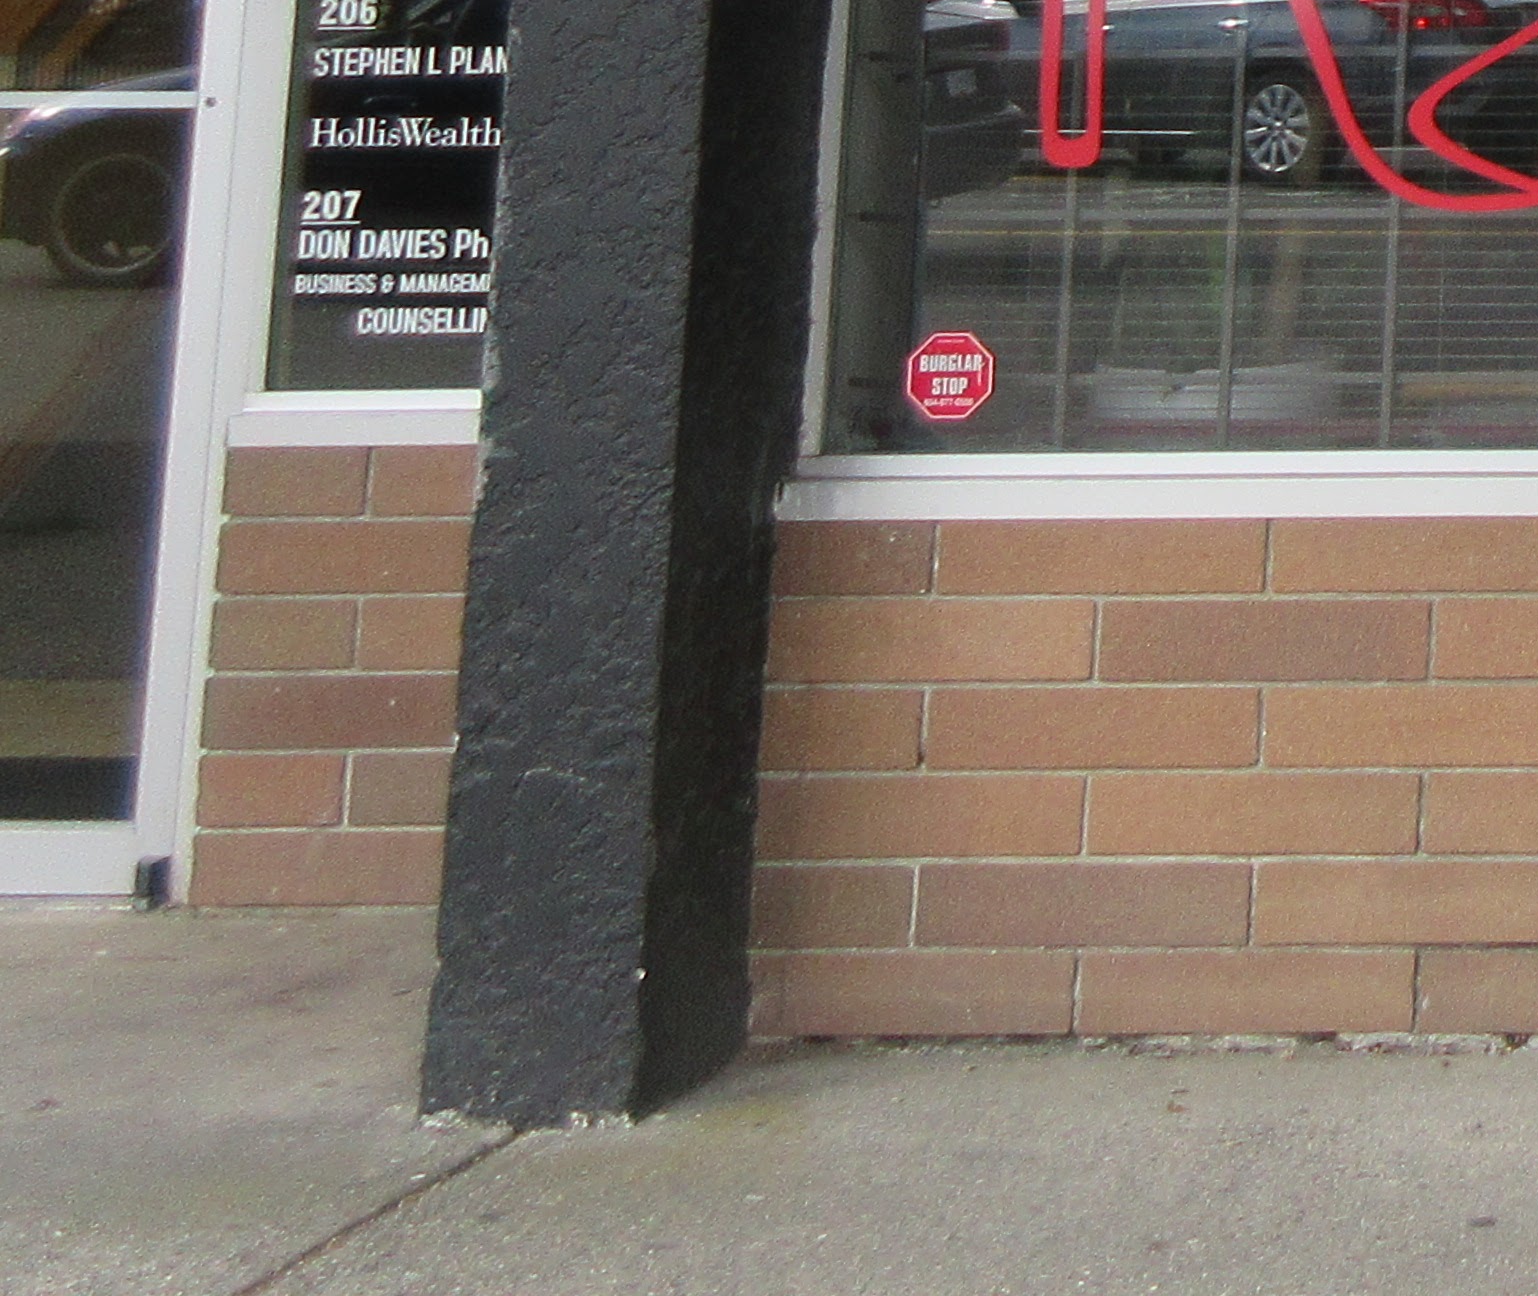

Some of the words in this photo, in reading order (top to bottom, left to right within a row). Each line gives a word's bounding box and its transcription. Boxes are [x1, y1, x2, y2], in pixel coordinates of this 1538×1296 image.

[313, 47, 420, 77] STEPHEN
[427, 47, 442, 75] L
[309, 117, 501, 147] HollisWealth
[301, 190, 361, 225] 207
[298, 230, 350, 259] DON
[359, 229, 447, 259] DAVIES
[295, 274, 377, 294] BUSINESS
[381, 274, 395, 293] &
[920, 354, 982, 372] BURGLAR
[931, 378, 968, 395] STOP
